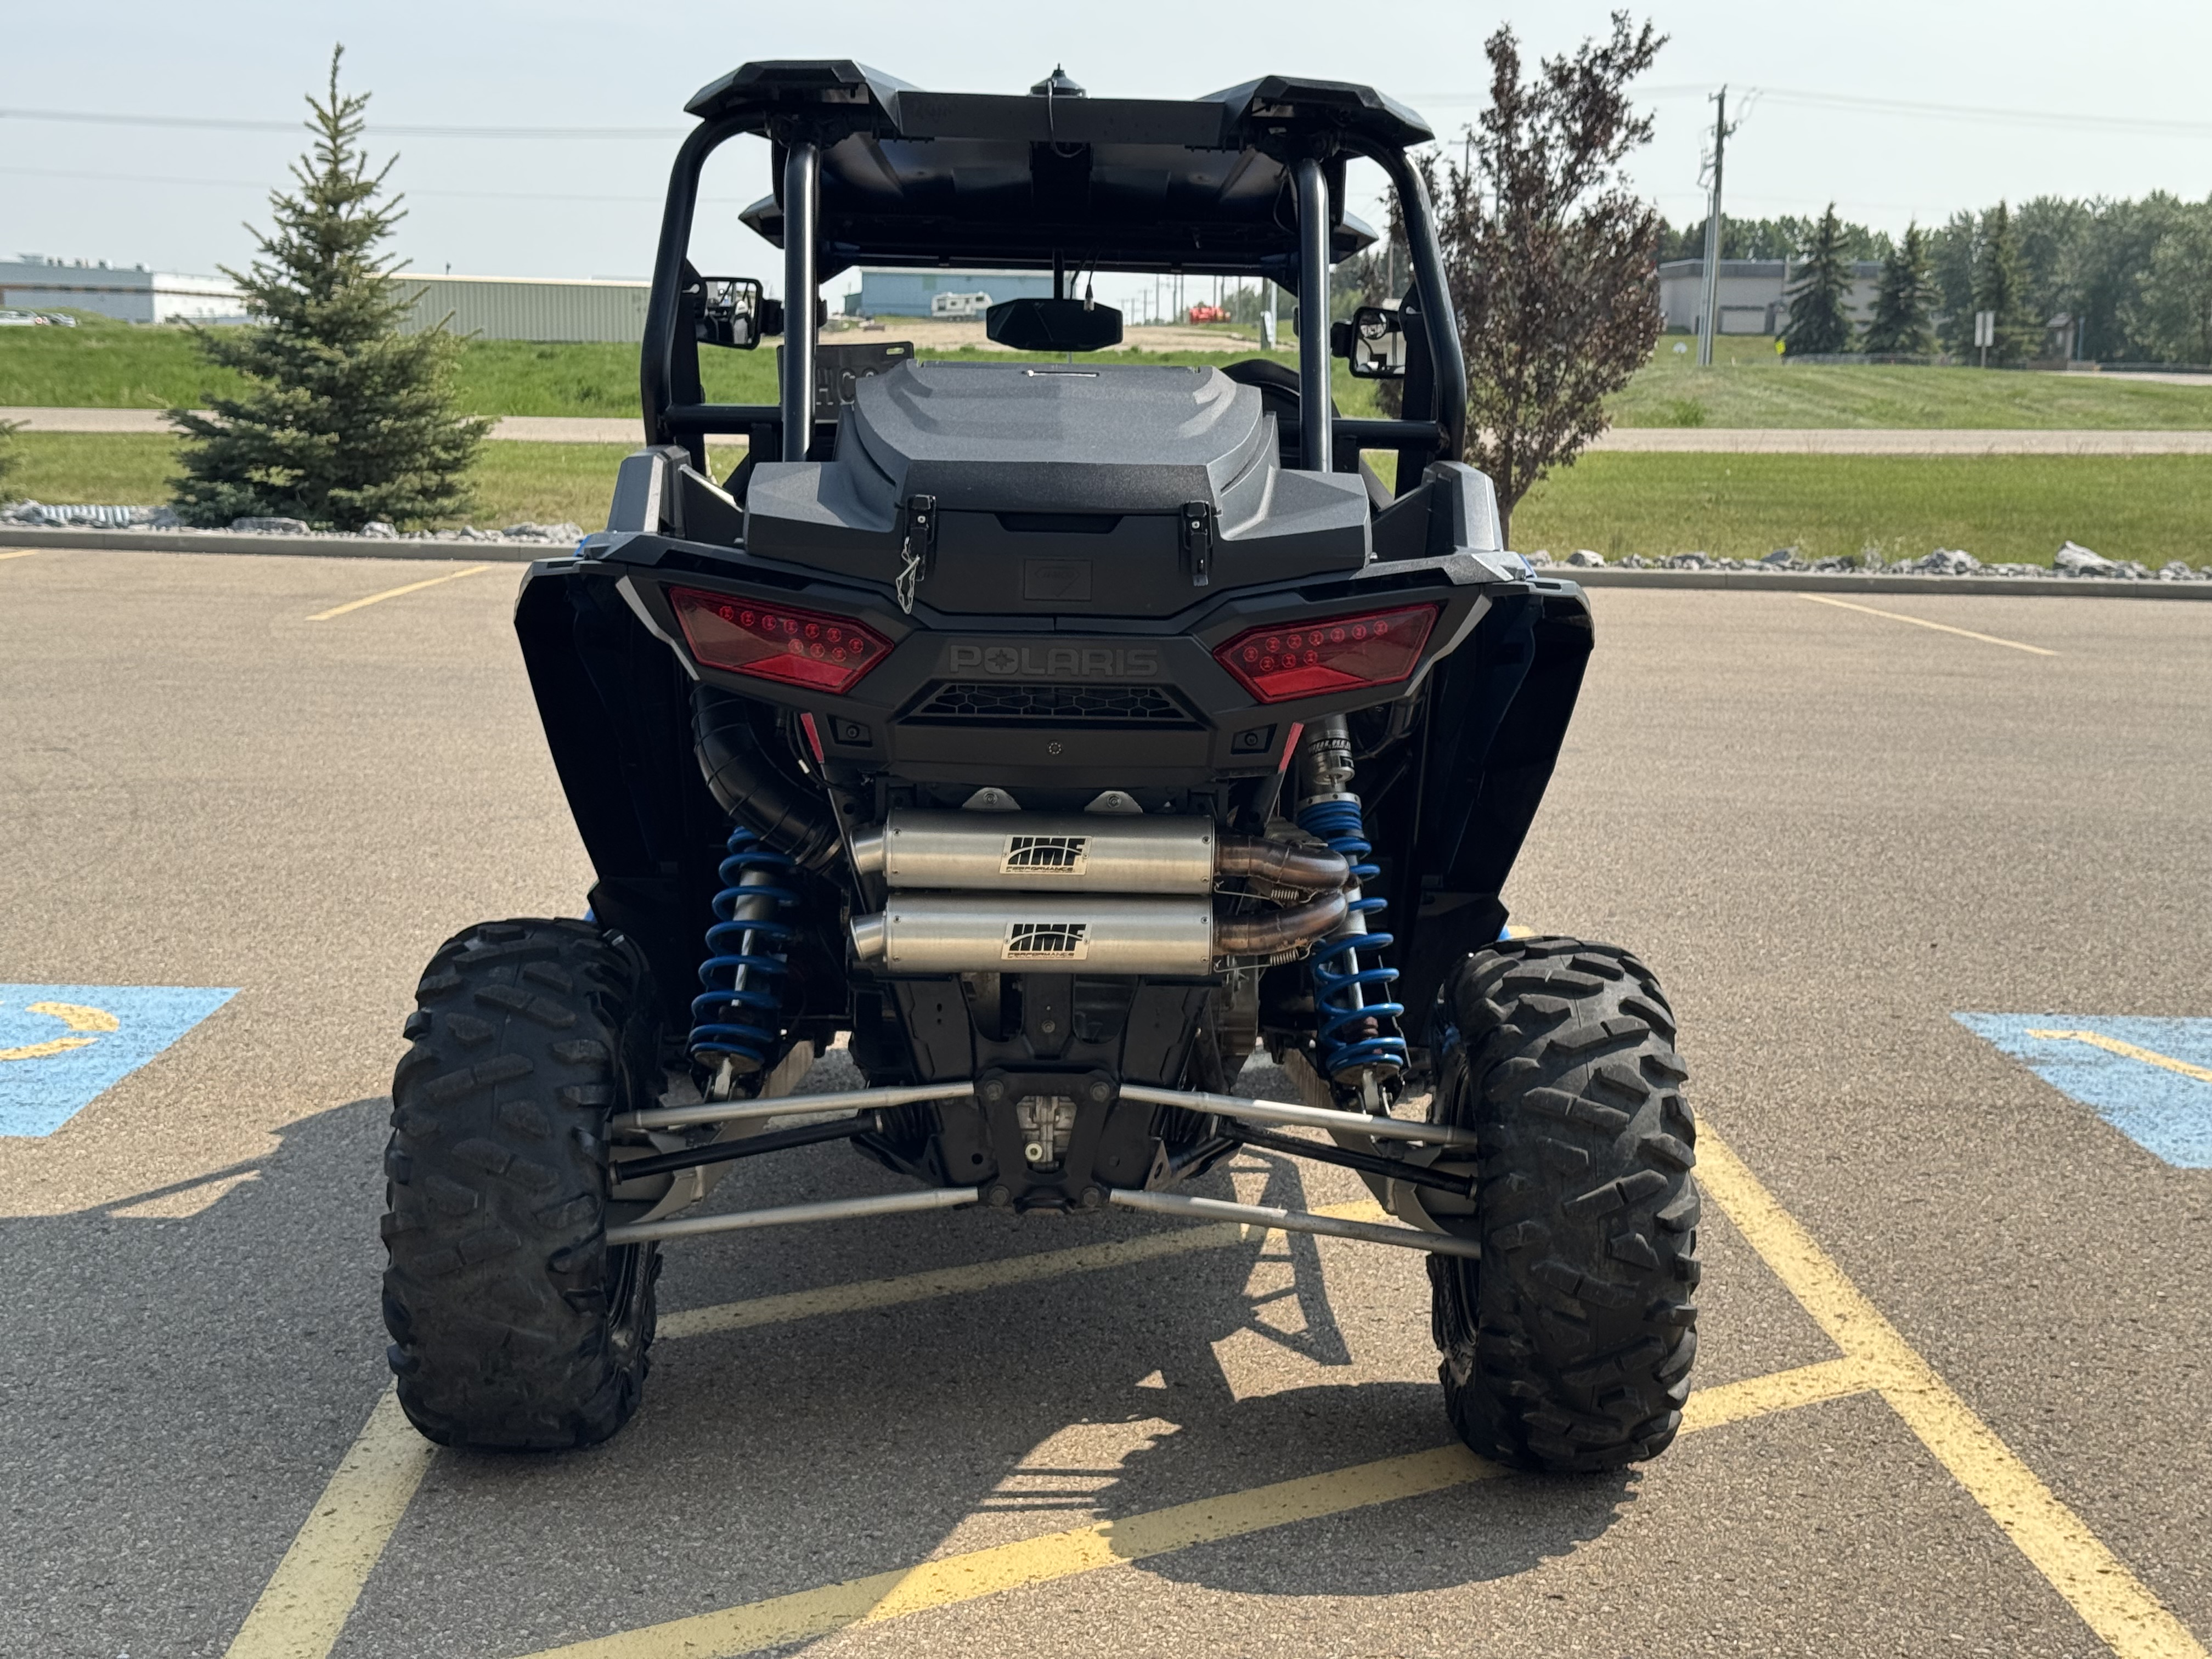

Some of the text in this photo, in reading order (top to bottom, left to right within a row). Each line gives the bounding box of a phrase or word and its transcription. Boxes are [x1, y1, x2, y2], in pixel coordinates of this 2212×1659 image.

[949, 645, 1159, 677] POLARIS
[1008, 837, 1086, 866] HMF
[1009, 923, 1087, 951] HMF
